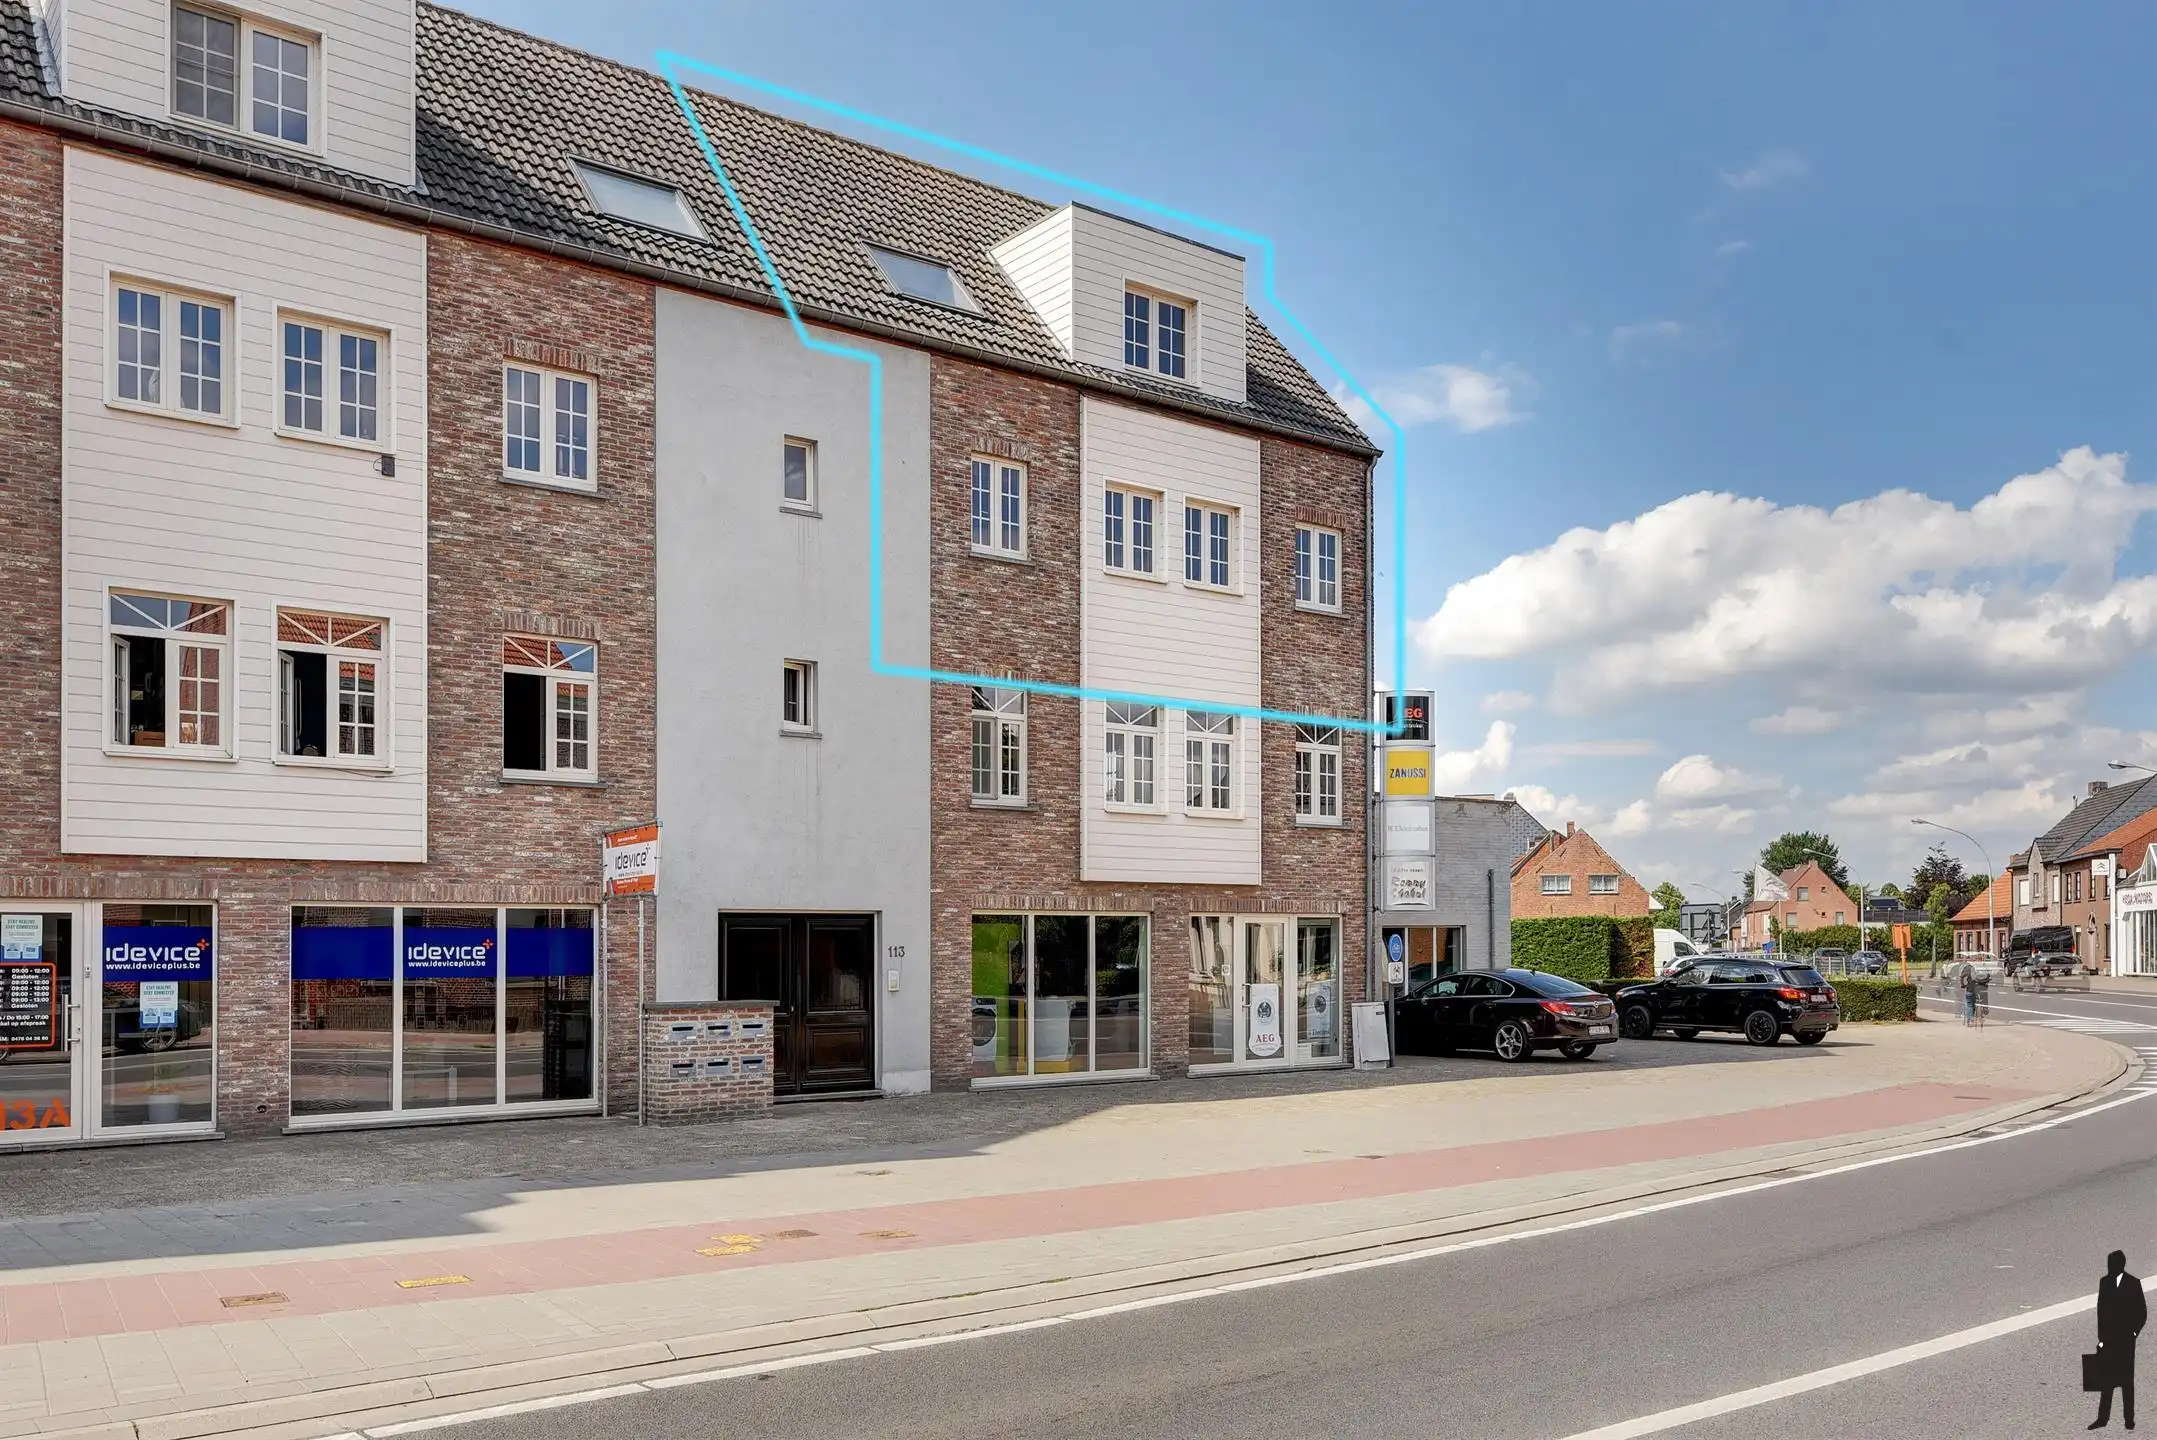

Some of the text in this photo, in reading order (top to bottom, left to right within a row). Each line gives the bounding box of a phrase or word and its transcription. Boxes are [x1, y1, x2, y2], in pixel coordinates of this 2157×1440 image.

[1389, 768, 1427, 779] ZANUSSI
[615, 851, 648, 871] idevice
[106, 943, 201, 962] idevice
[408, 942, 486, 960] idevice
[888, 945, 905, 958] 113
[106, 962, 201, 970] www.ideviceplus.be
[1255, 1033, 1275, 1043] AEG
